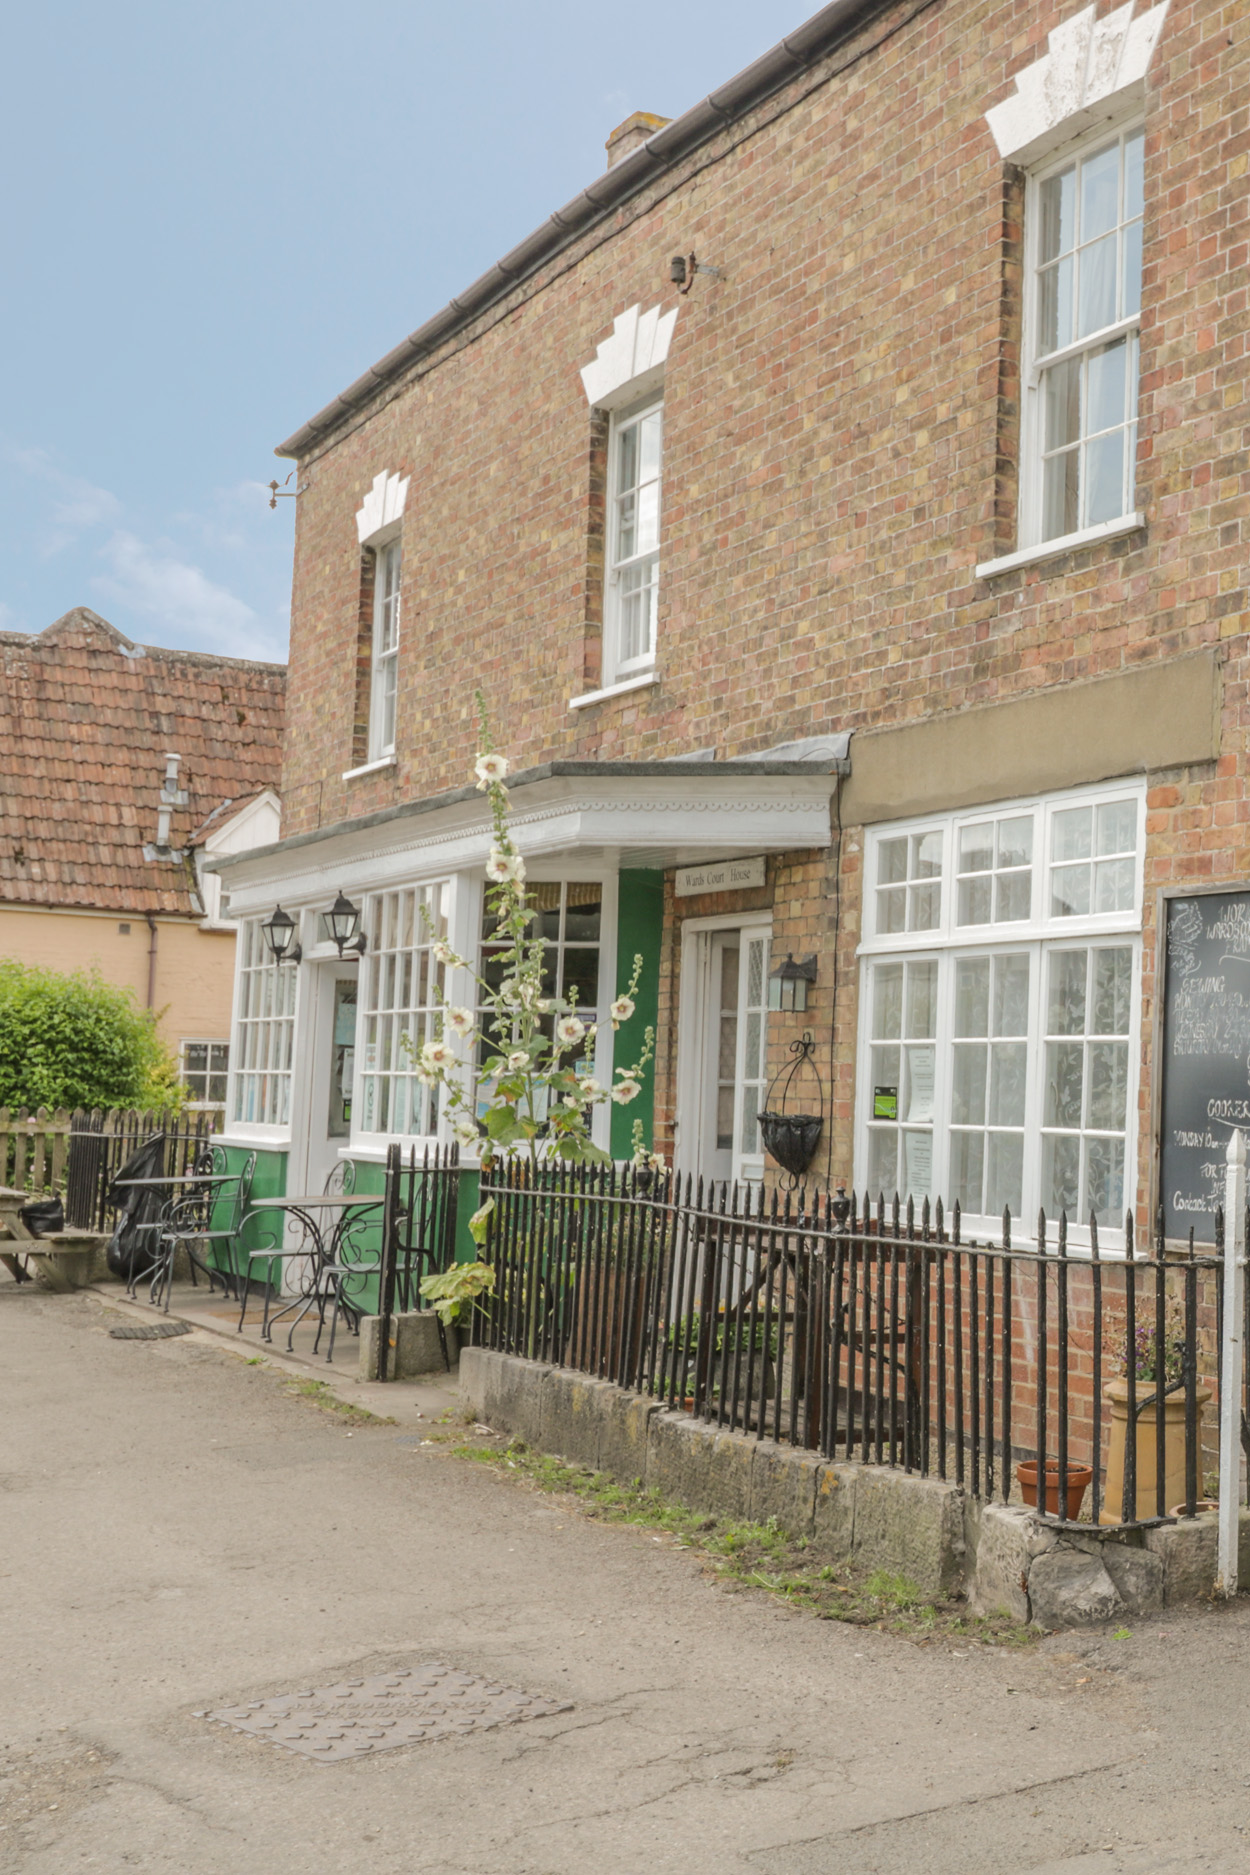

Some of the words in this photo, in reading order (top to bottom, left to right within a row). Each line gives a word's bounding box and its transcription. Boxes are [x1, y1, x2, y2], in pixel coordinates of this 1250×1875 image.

[685, 872, 705, 887] Wards
[706, 871, 725, 885] Court
[730, 868, 751, 882] House
[1180, 975, 1226, 994] SEWING
[1173, 1189, 1207, 1212] Contact
